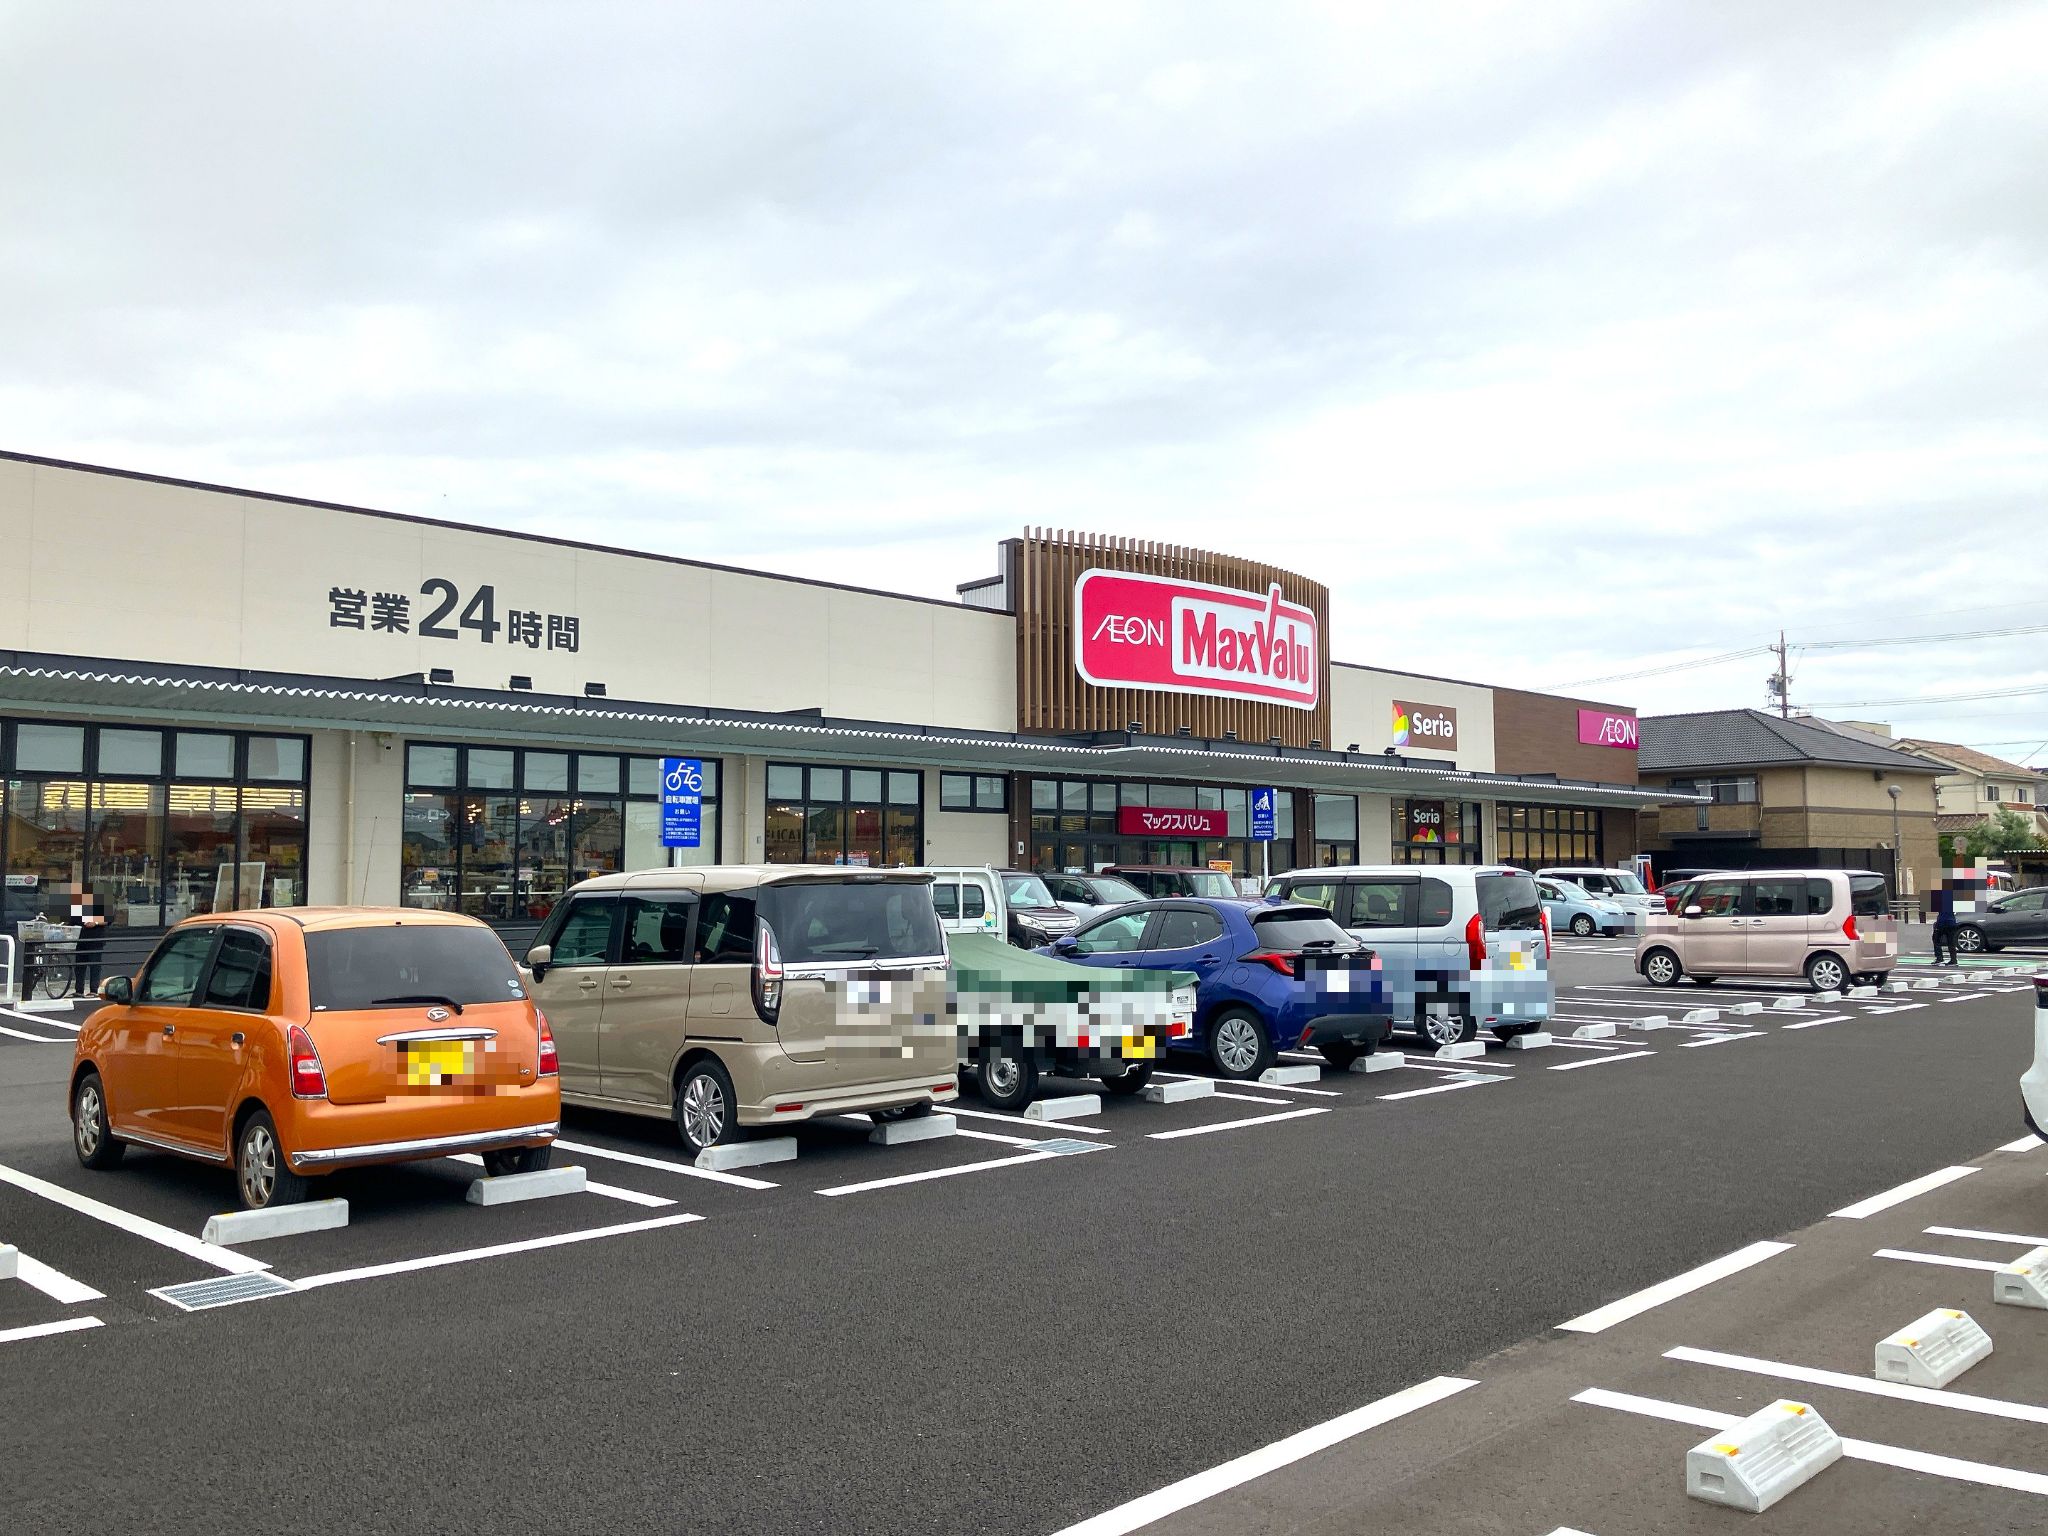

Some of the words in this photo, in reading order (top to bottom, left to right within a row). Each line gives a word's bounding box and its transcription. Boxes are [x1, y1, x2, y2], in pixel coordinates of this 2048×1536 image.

[1182, 589, 1310, 684] MaxValu
[1412, 711, 1454, 738] Seria
[1142, 813, 1211, 831] マックスバリュ
[1413, 808, 1440, 824] Seria
